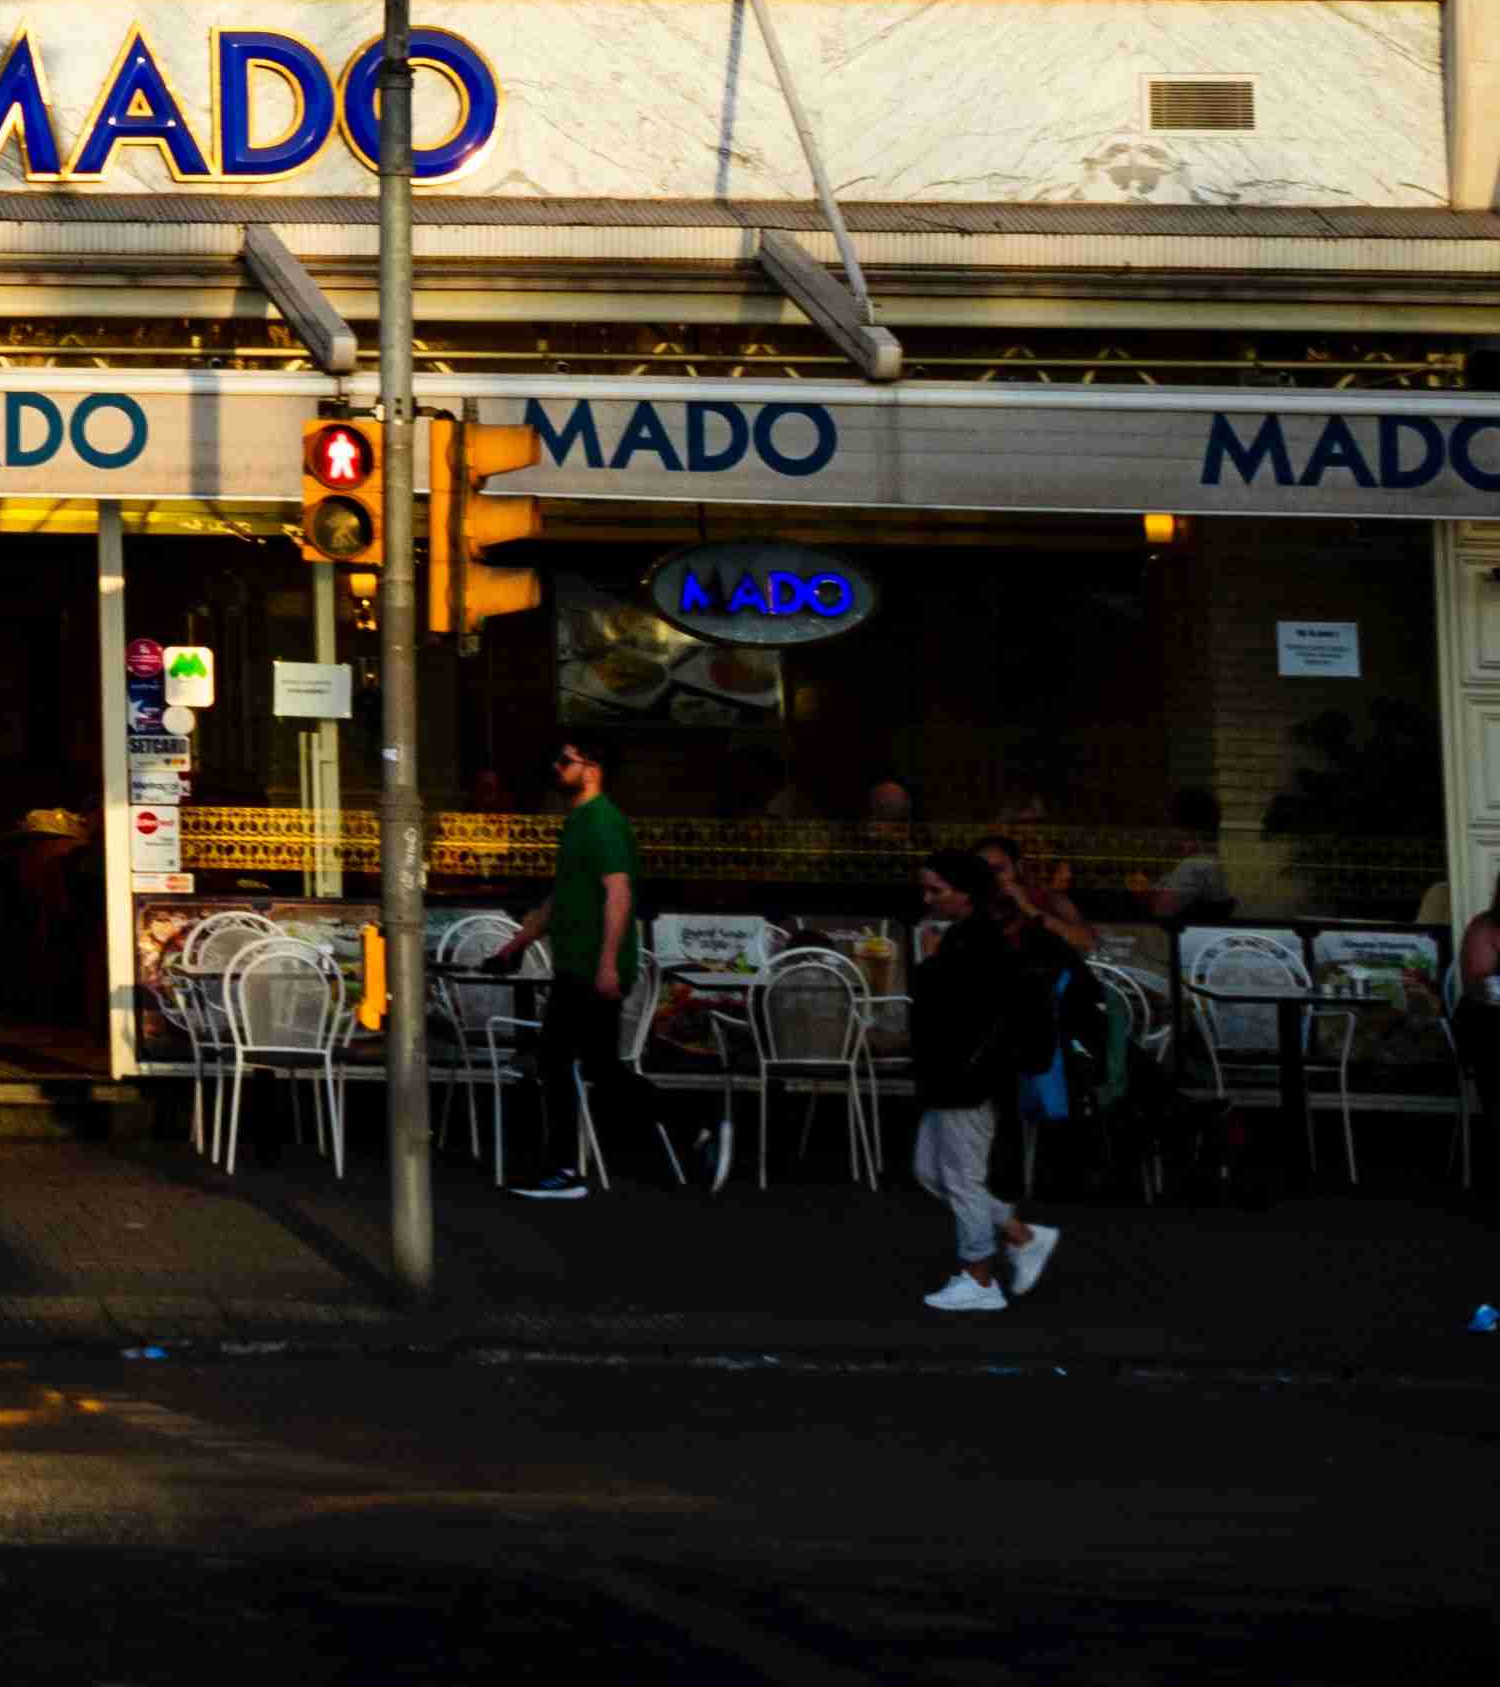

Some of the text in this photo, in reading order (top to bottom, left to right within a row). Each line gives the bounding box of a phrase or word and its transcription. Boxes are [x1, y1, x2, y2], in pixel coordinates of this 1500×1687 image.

[524, 397, 838, 476] MADO
[1200, 412, 1500, 493] MADO
[680, 566, 855, 620] MADO
